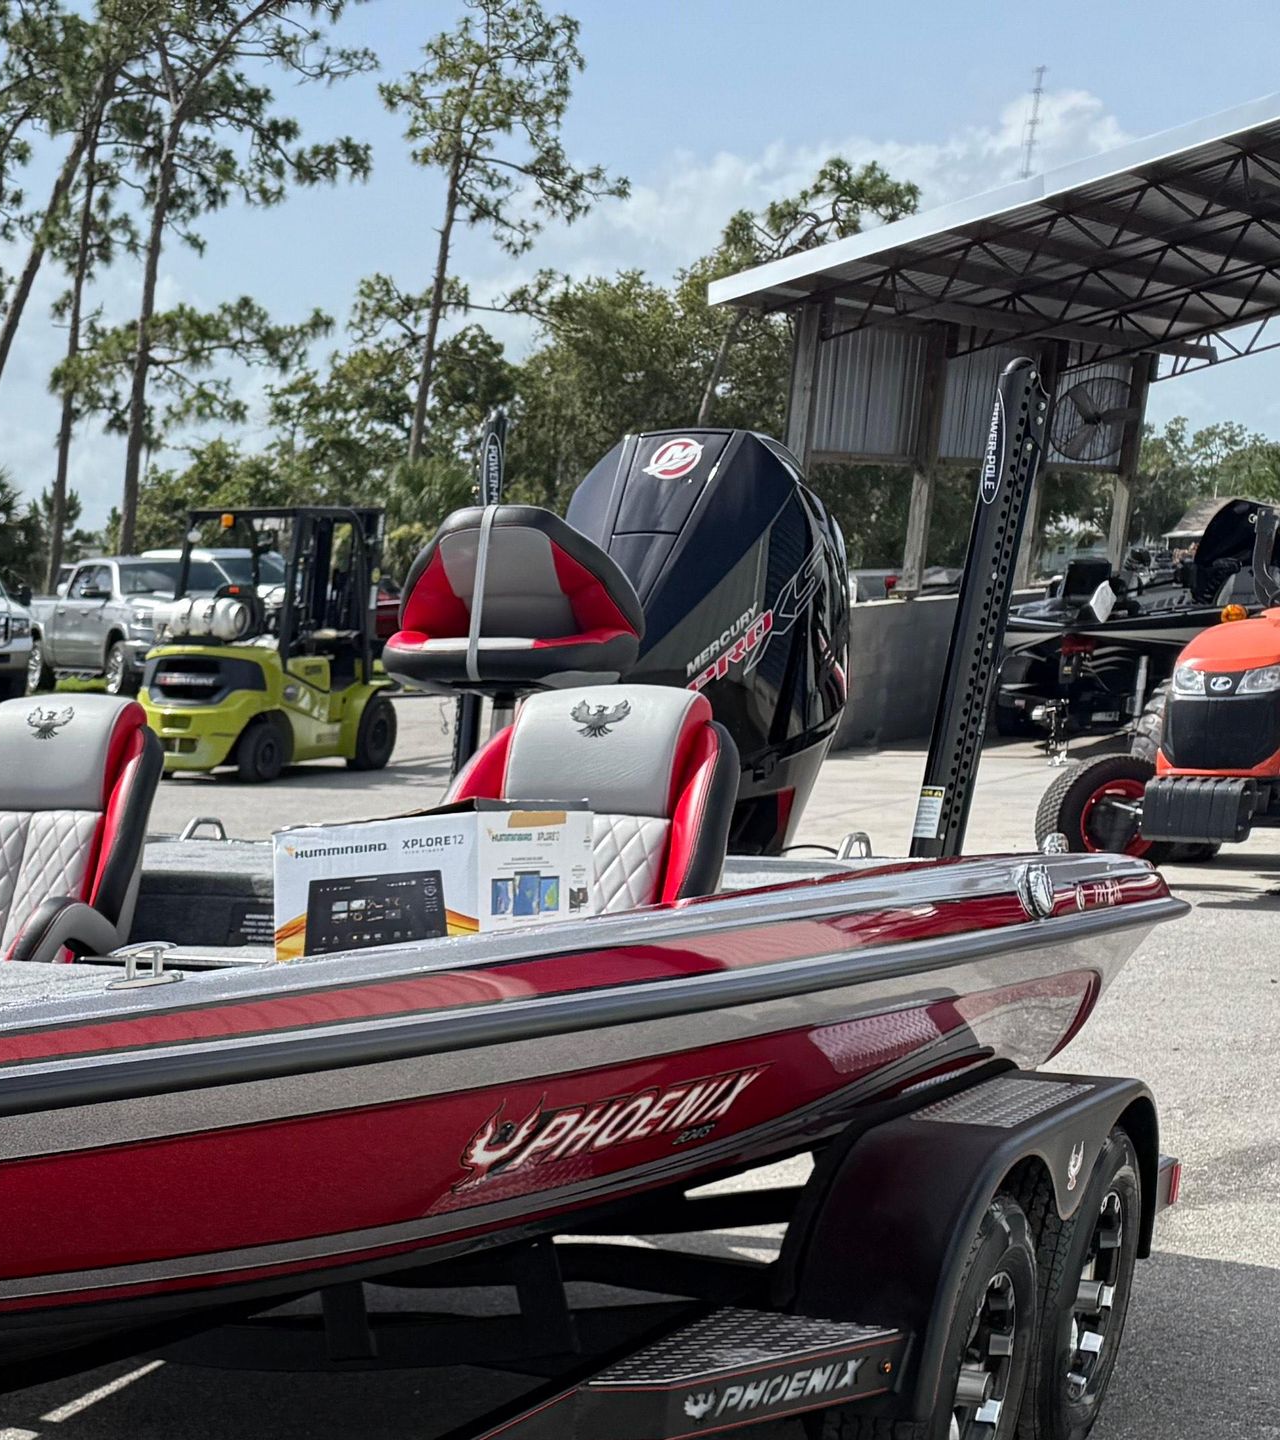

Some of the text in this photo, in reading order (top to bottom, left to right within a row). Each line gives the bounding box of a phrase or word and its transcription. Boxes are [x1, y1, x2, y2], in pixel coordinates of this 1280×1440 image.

[984, 402, 1000, 490] POWER-POLE
[686, 602, 758, 677] MERCURY
[686, 609, 774, 691] PRO
[295, 843, 388, 859] HUMMINBIRD
[504, 1068, 770, 1172] PHOENIX
[714, 1357, 867, 1418] PHOENIX
